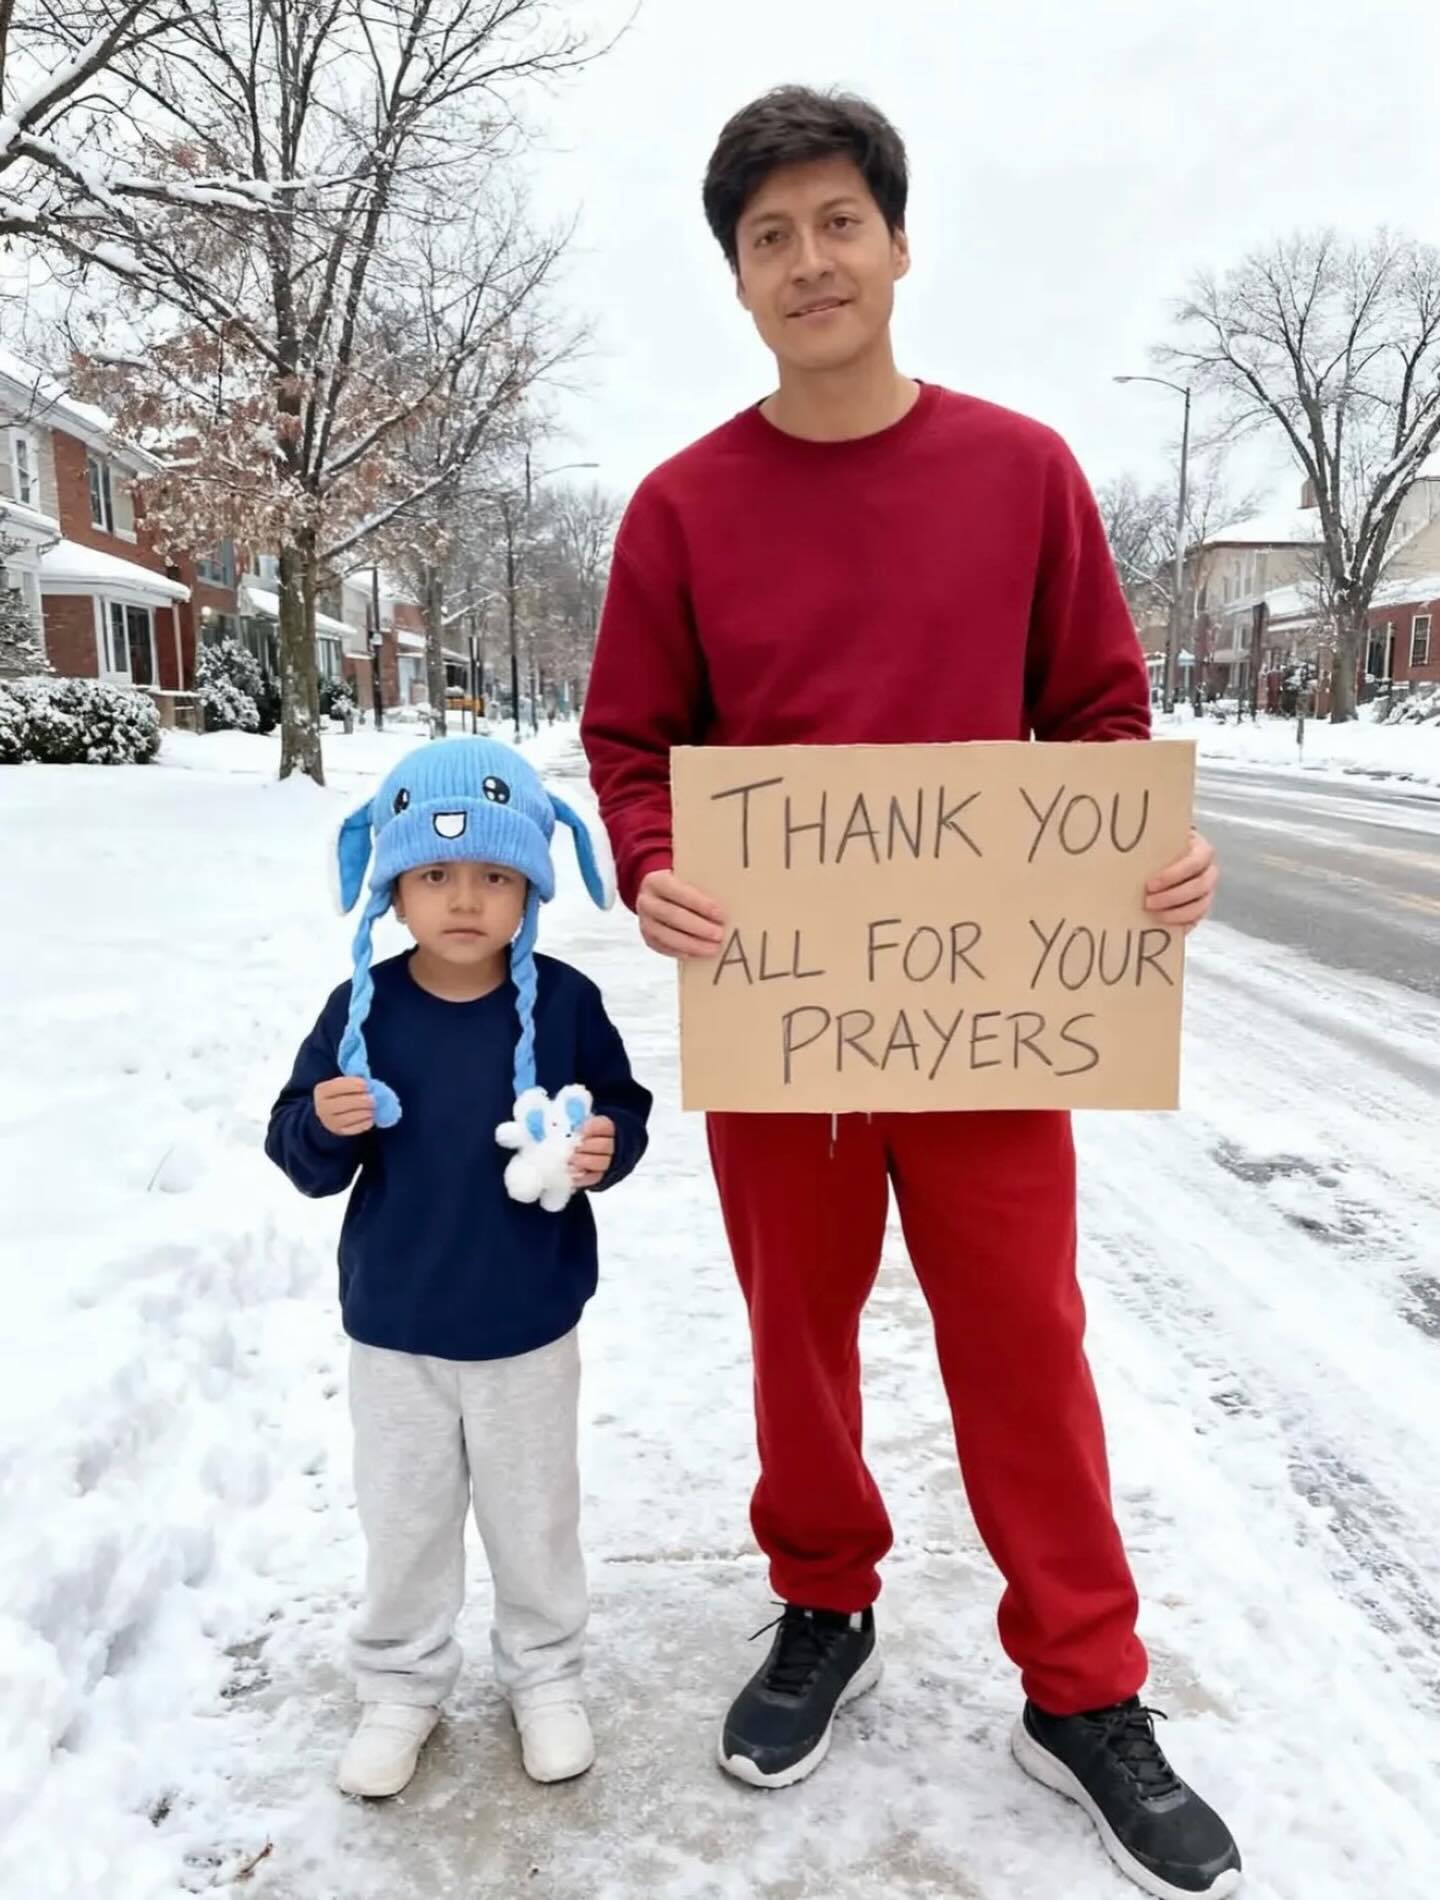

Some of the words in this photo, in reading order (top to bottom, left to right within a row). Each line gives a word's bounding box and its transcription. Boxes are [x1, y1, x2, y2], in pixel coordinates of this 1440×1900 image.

[711, 777, 982, 868] THANK
[1020, 785, 1149, 863] YOU
[712, 928, 825, 985] ALL
[868, 919, 985, 983] FOR
[1029, 918, 1174, 990] YOUR
[782, 1006, 1099, 1084] PRAYERS
